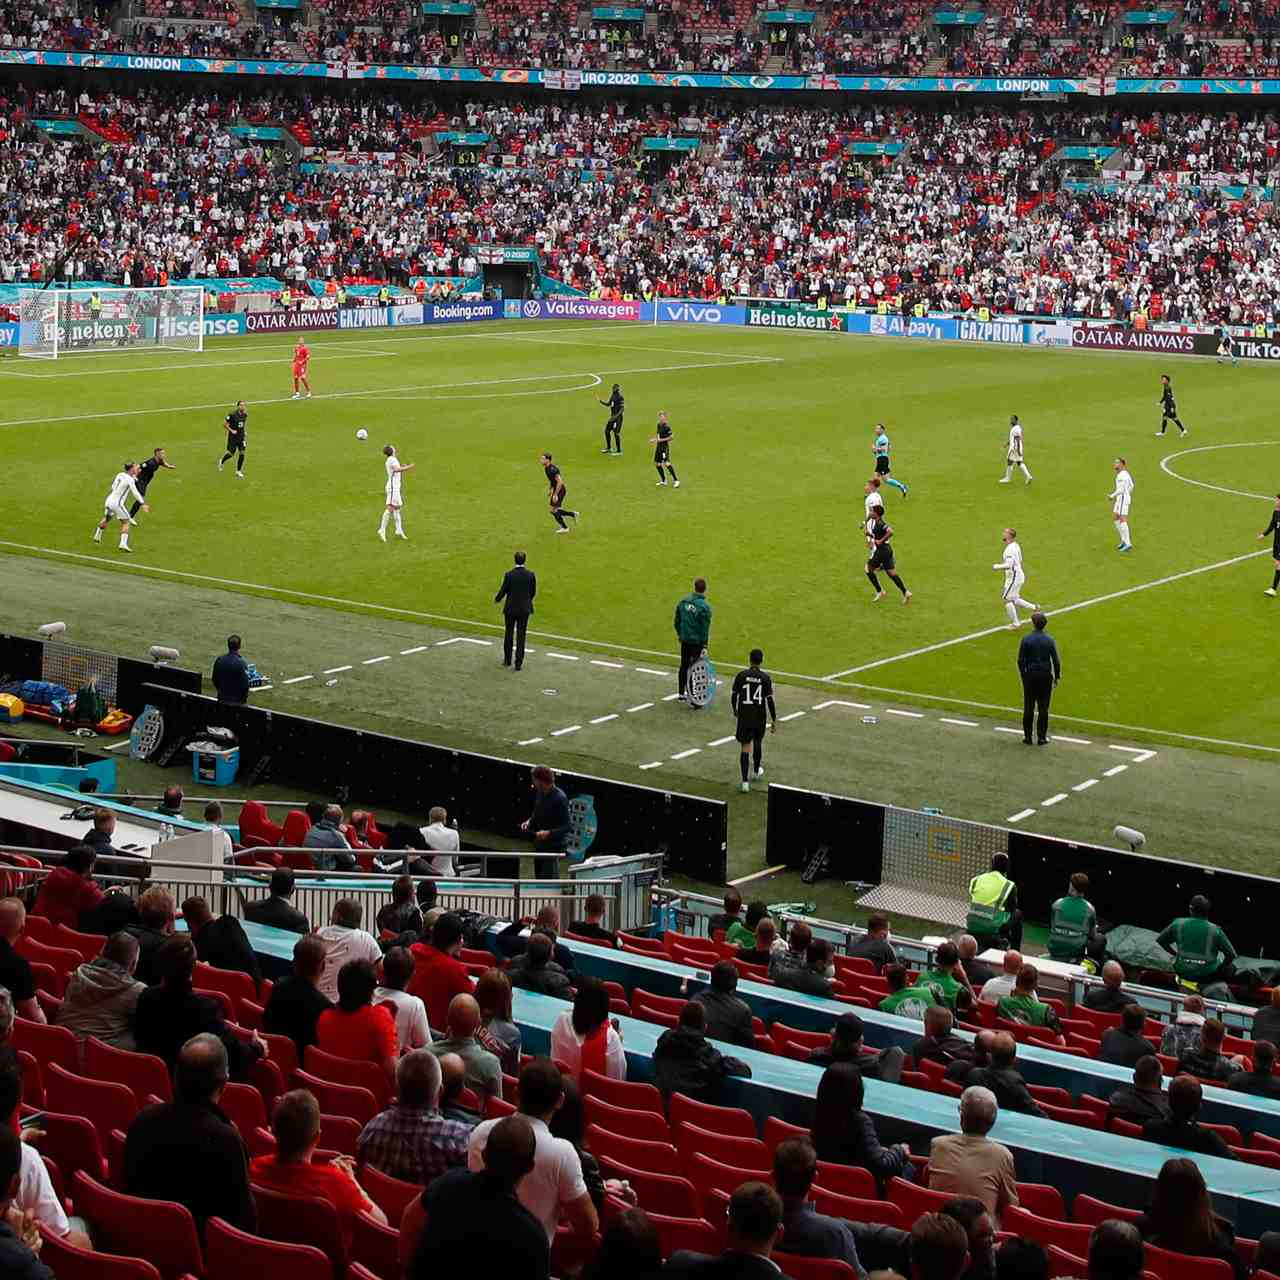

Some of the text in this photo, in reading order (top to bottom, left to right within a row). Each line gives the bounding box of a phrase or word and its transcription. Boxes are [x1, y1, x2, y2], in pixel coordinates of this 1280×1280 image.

[128, 56, 181, 71] LONDON
[580, 72, 606, 85] URO
[607, 73, 640, 85] 2020
[996, 79, 1049, 92] LONDON
[246, 310, 337, 330] QATAR AIRWAYS
[340, 307, 388, 328] GAZPROM
[433, 304, 493, 319] Booking.com
[546, 301, 635, 319] Volkswagen
[667, 303, 721, 322] vivo
[749, 309, 826, 329] Heineken
[43, 322, 126, 342] Heneken
[888, 317, 935, 338] Alpay
[960, 320, 1024, 343] GAZPROM
[1073, 328, 1124, 346] QATAR
[1127, 331, 1194, 350] AIRWAYS
[742, 683, 763, 705] 14
